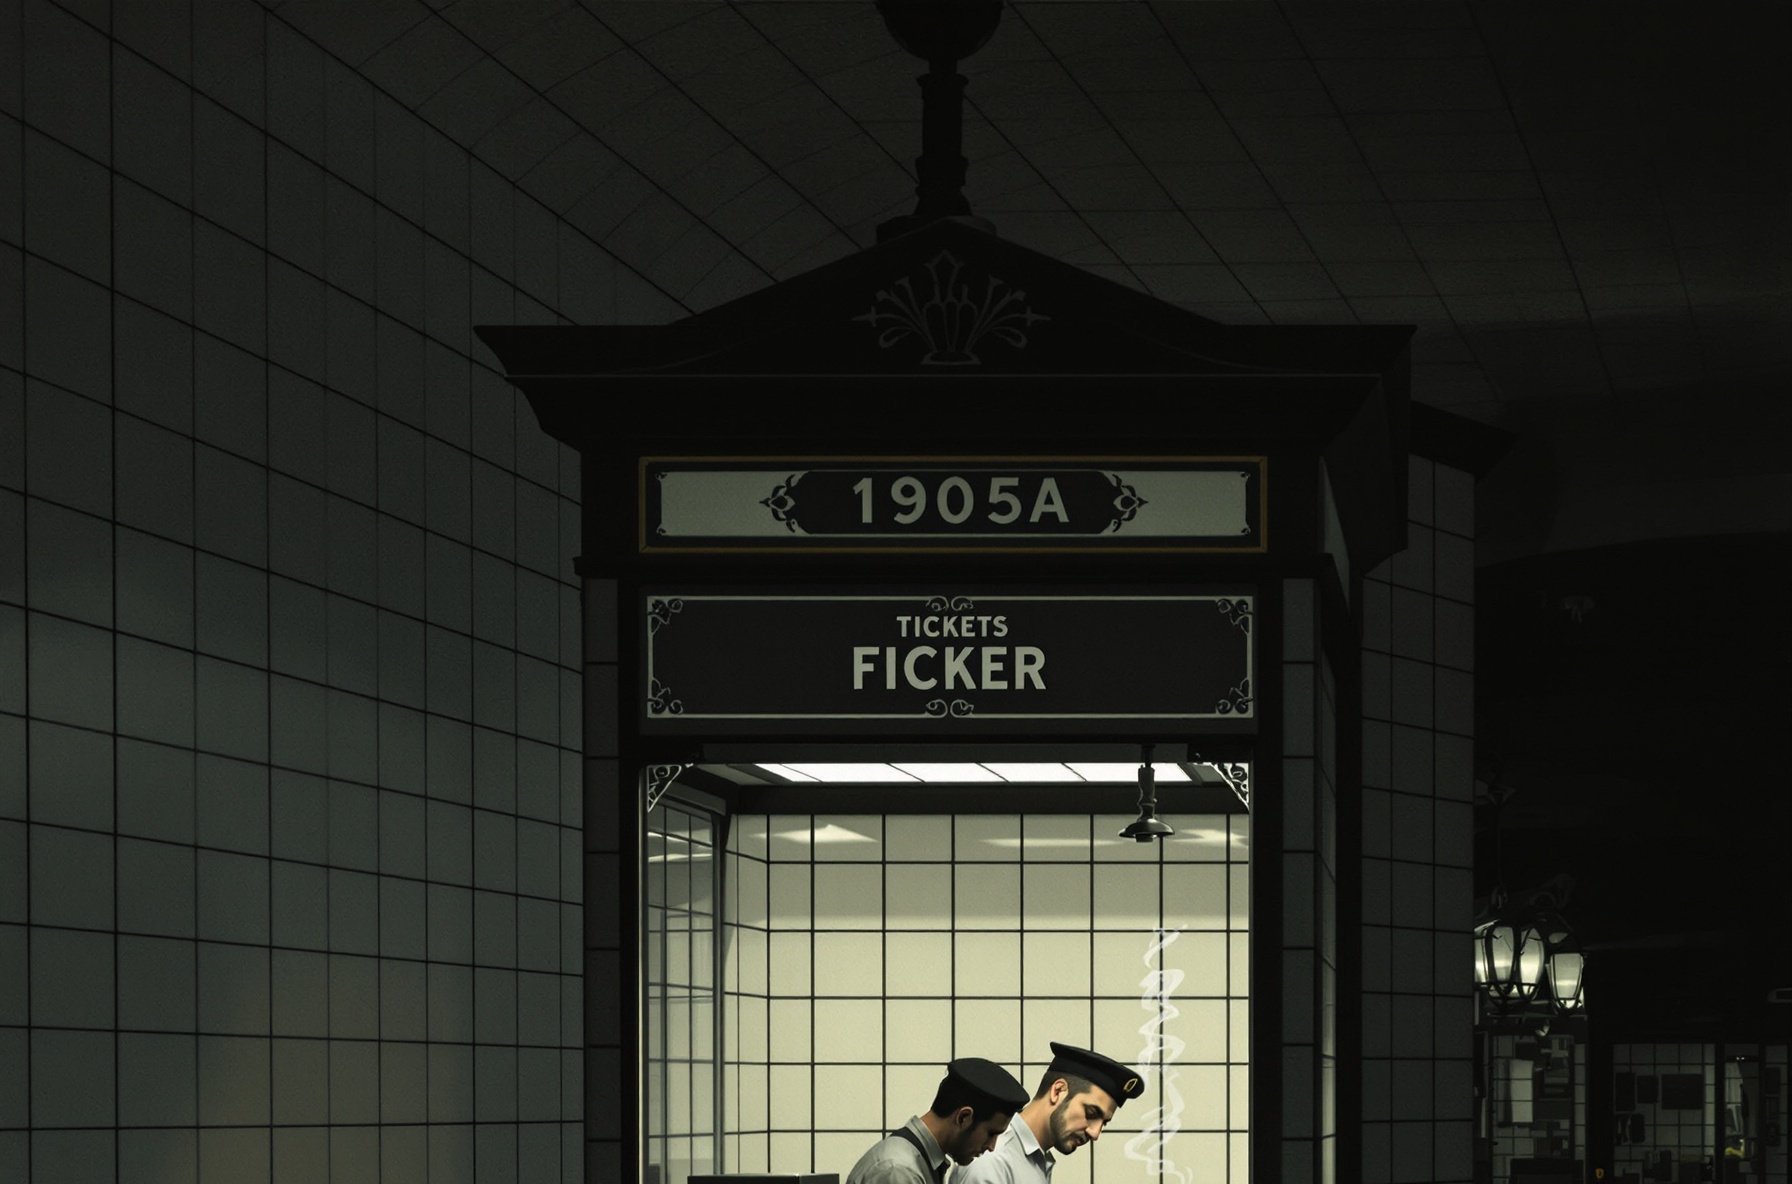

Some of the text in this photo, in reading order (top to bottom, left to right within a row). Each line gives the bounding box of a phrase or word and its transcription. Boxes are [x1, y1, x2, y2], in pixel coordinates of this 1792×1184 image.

[853, 477, 1070, 524] 1905A
[896, 615, 1009, 638] TICKETS
[853, 646, 1047, 690] FICKER
